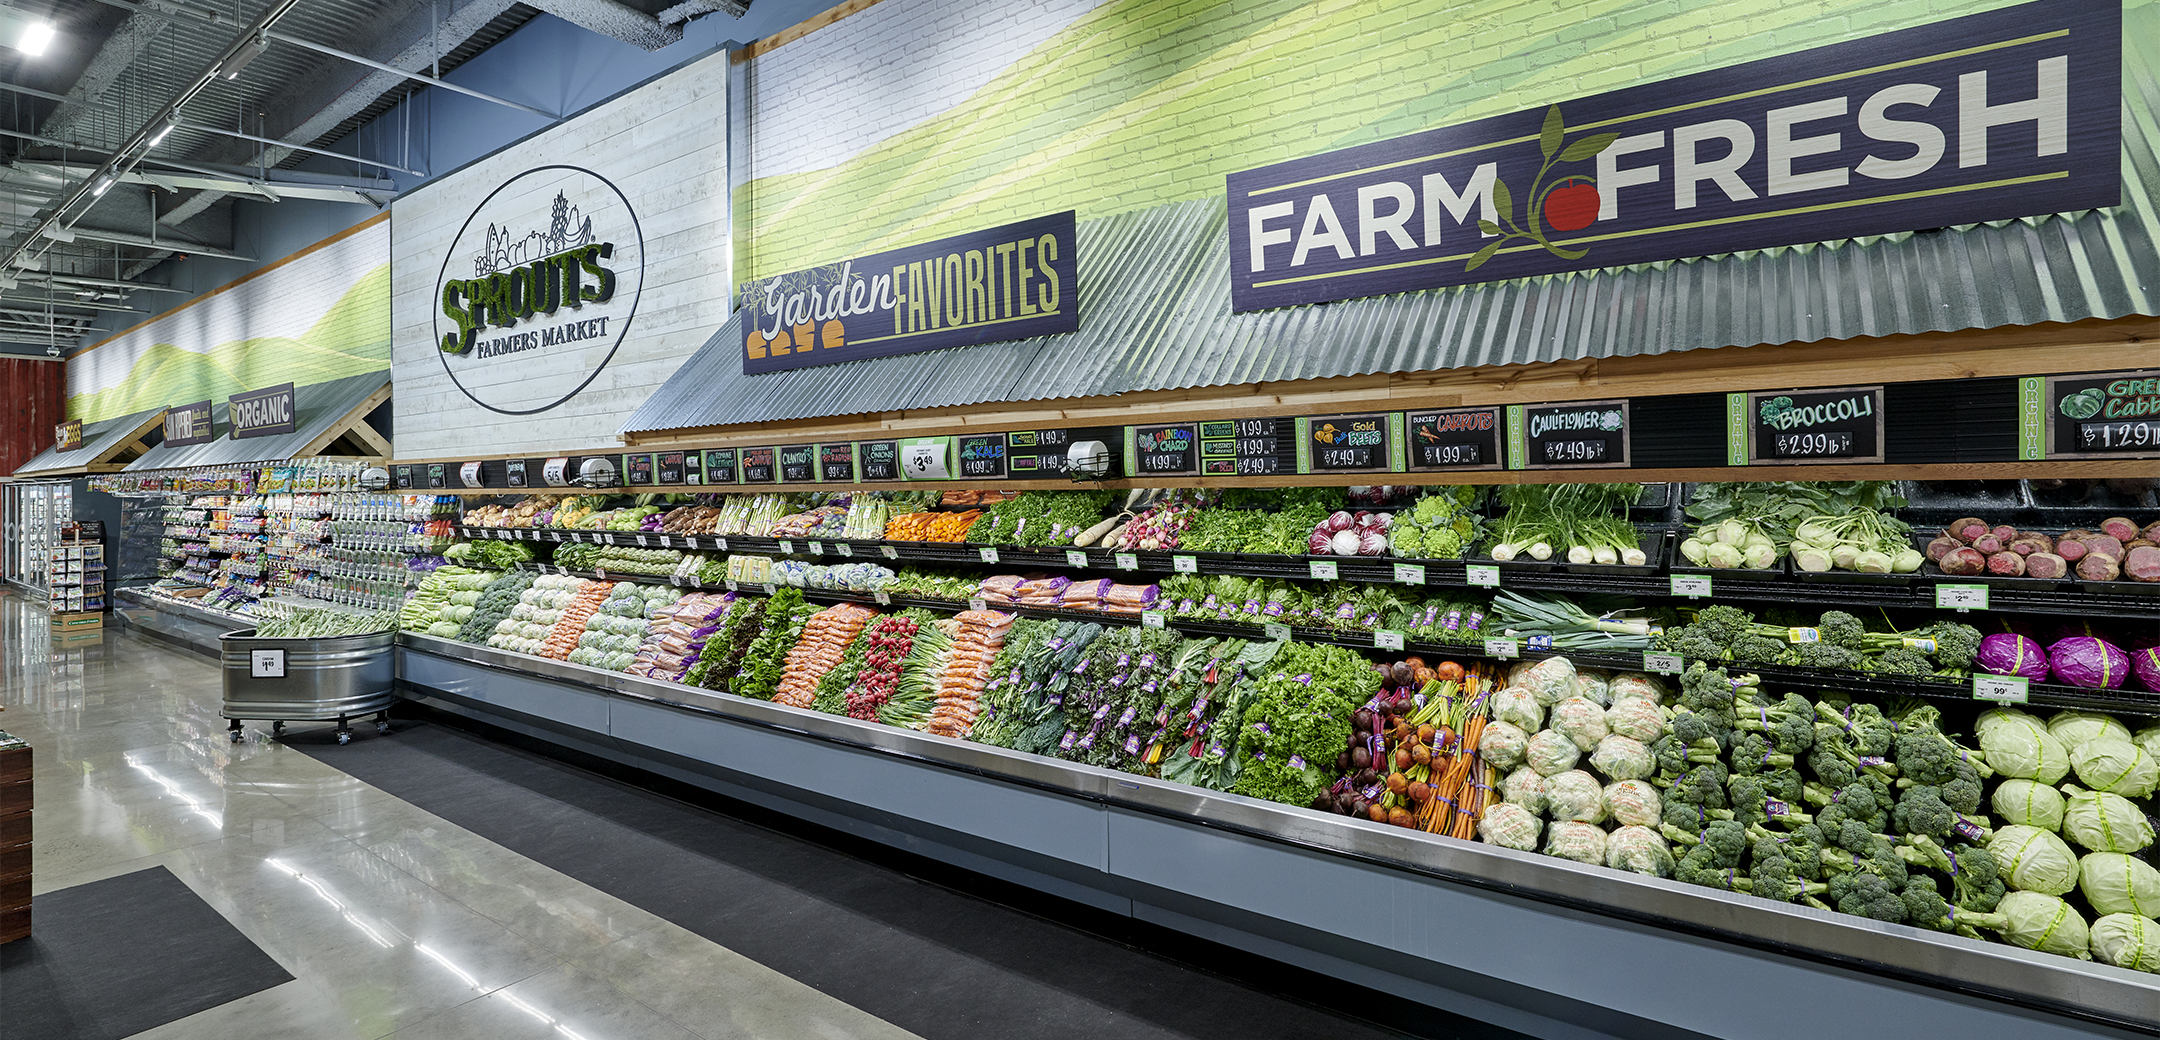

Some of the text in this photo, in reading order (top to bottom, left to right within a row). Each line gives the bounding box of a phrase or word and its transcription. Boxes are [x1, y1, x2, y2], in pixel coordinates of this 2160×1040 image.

[1249, 55, 2068, 273] FARM FRESH
[762, 233, 1060, 340] Garden FAVORITES
[441, 242, 615, 354] SPROUTS
[477, 316, 609, 359] FARMERS MARKET
[2105, 378, 2160, 398] GRE
[237, 394, 290, 428] ORGANIC
[1412, 415, 1437, 424] BUNCHED
[1777, 395, 1873, 431] BROCCOLI
[2024, 378, 2039, 460] ORGANIC
[1352, 421, 1376, 431] Gold
[1436, 413, 1494, 433] CARROTS
[1732, 394, 1743, 466] ORGANIC
[67, 423, 81, 444] EGGS
[917, 438, 935, 446] ORGANIC
[966, 438, 988, 446] GREEN
[1155, 429, 1193, 444] RAINBOW
[1348, 430, 1382, 446] BEETS
[1393, 413, 1402, 472] ORGANIC
[1510, 405, 1520, 469] ORGANIC
[2084, 422, 2150, 448] $1.29
[870, 450, 894, 458] ONIONS
[872, 443, 889, 451] GREEN
[976, 445, 1004, 459] KALE
[1159, 440, 1188, 452] CHARD
[1298, 418, 1307, 473] ORGANIC
[1546, 441, 1585, 460] $2.49
[1778, 433, 1839, 455] $2.99 lb
[715, 459, 734, 468] LETTUCE
[782, 451, 807, 465] CILANTRO
[1324, 449, 1354, 466] $2.49
[1424, 446, 1460, 464] $1.99
